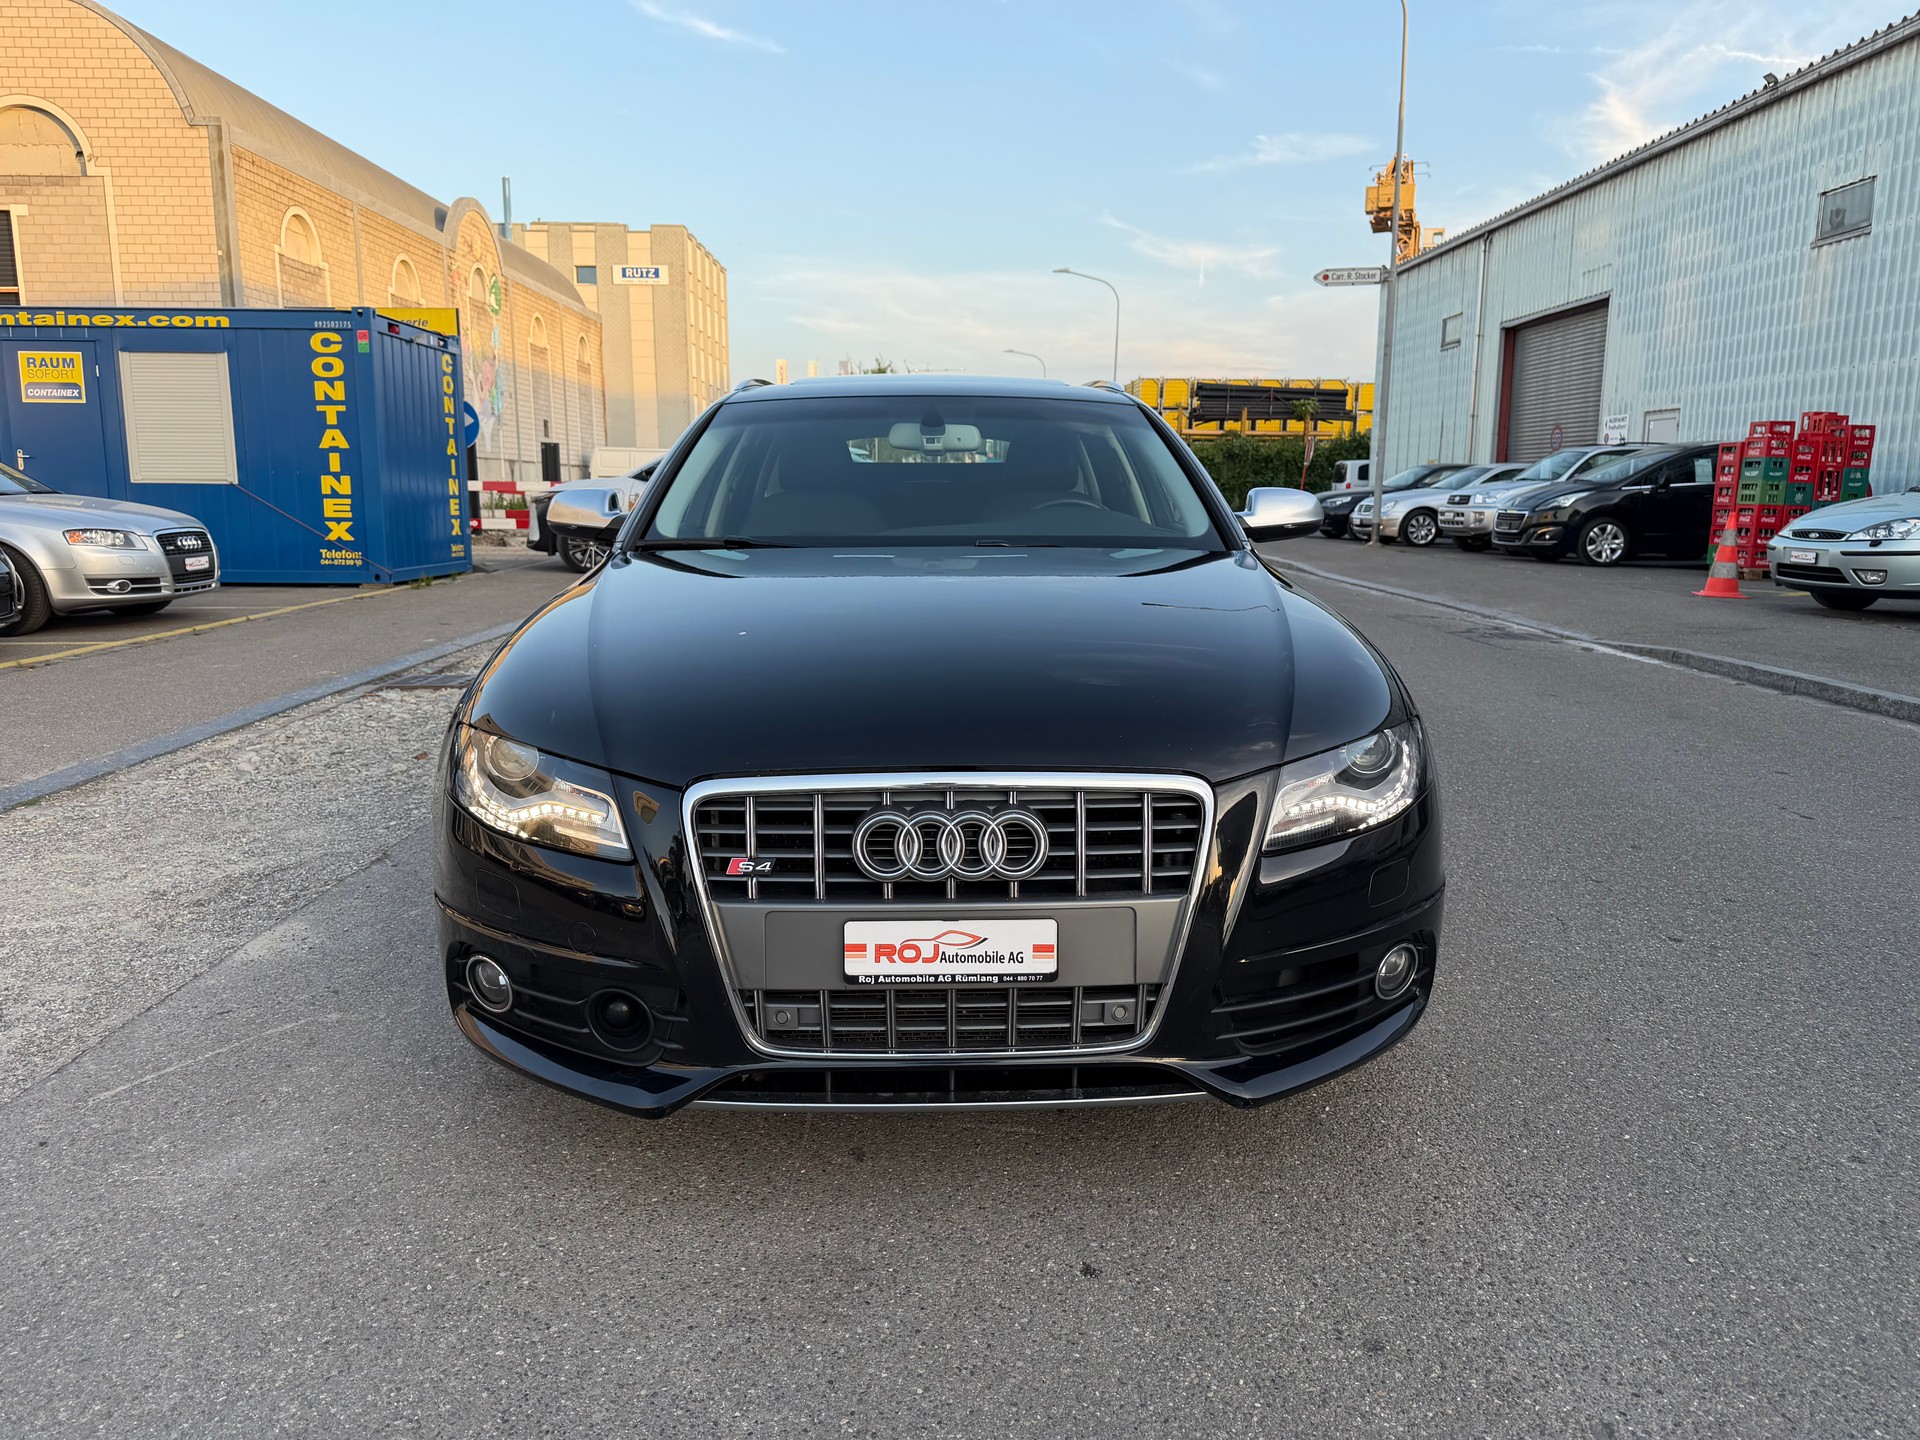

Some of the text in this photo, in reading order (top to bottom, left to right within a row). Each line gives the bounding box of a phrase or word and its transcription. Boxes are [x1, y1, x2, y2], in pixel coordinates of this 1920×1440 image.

[625, 268, 655, 278] RUTZ
[1355, 272, 1377, 280] Stocker
[26, 357, 75, 369] RAUM
[27, 369, 75, 379] SOFORT
[27, 388, 79, 397] CONTAINEX
[309, 331, 355, 542] CONTAINEX
[441, 354, 461, 536] CONTAINEX
[320, 549, 362, 559] Telefon:
[737, 861, 772, 873] S4
[874, 943, 1024, 964] ROJ Automobile AG
[858, 975, 875, 984] Roj
[878, 975, 935, 983] Automobile
[937, 974, 952, 982] AG
[955, 974, 999, 984] Rümlang
